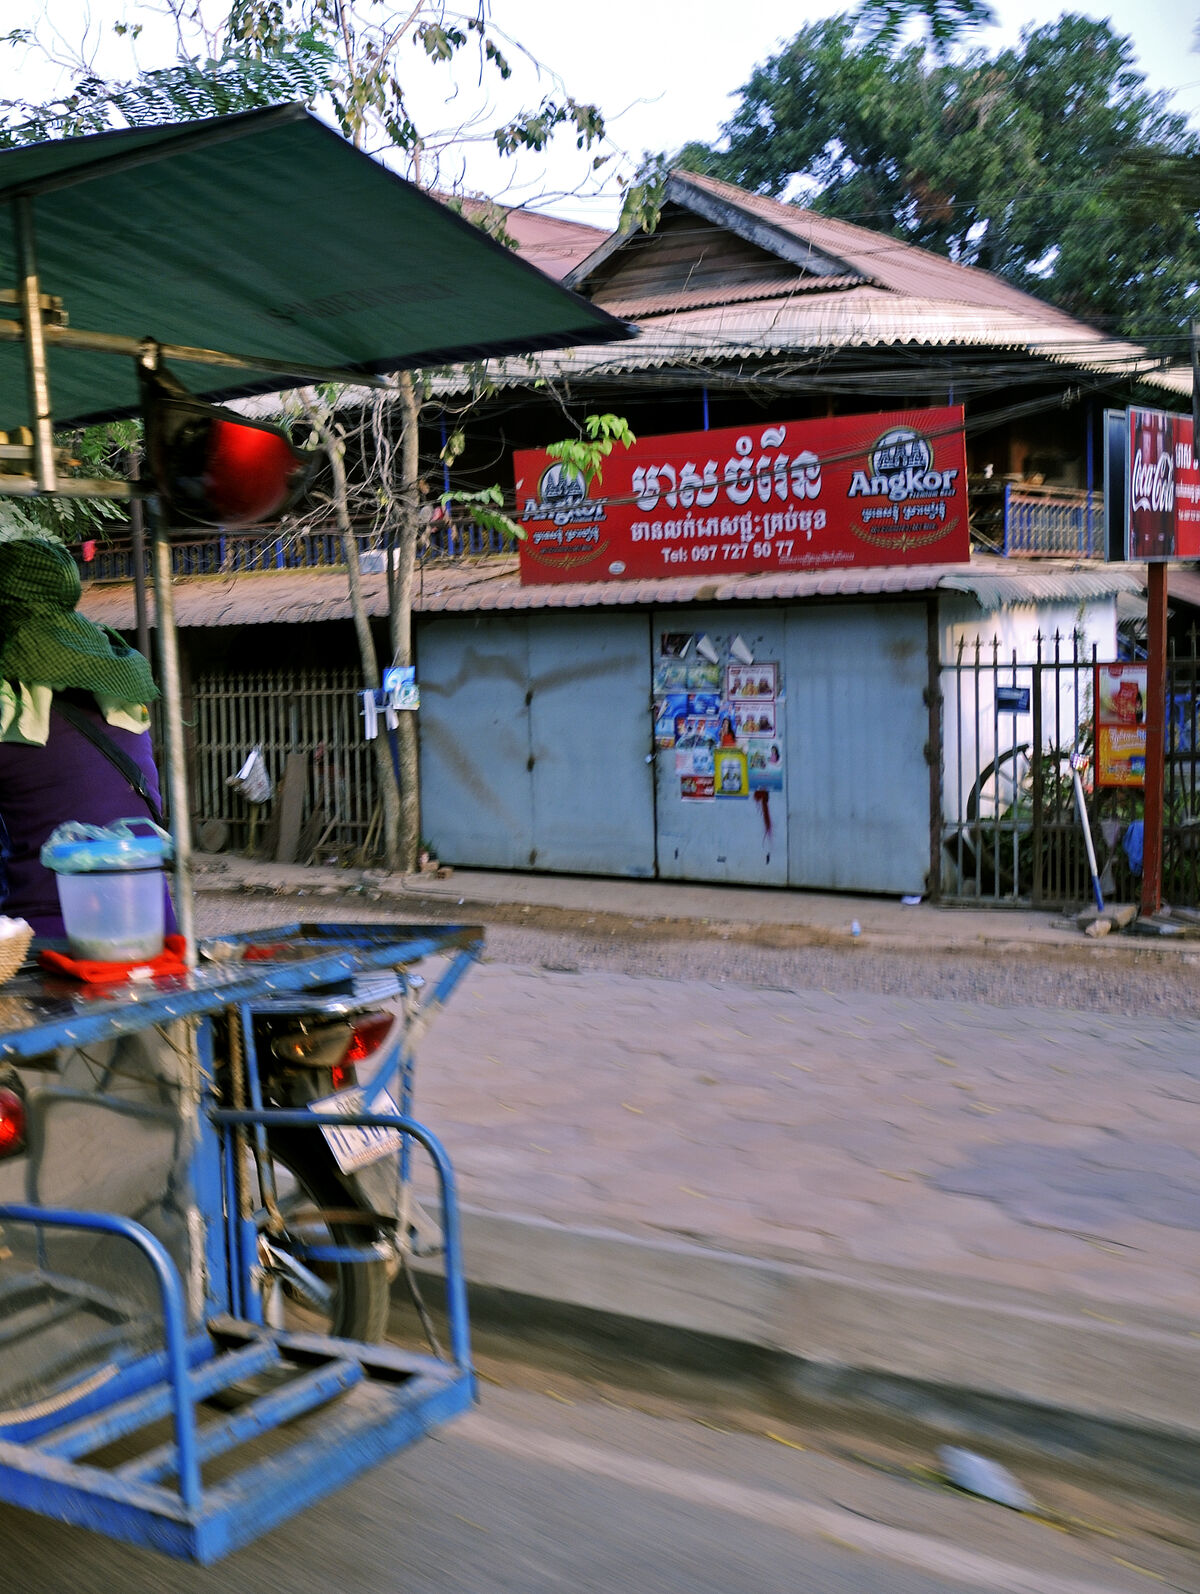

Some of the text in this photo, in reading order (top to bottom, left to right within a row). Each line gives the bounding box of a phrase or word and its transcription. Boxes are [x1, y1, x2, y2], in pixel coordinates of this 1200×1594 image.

[848, 468, 959, 501] Angkor
[661, 547, 688, 563] Tel:
[692, 545, 717, 562] 097
[723, 542, 749, 559] 727
[775, 540, 795, 557] 77
